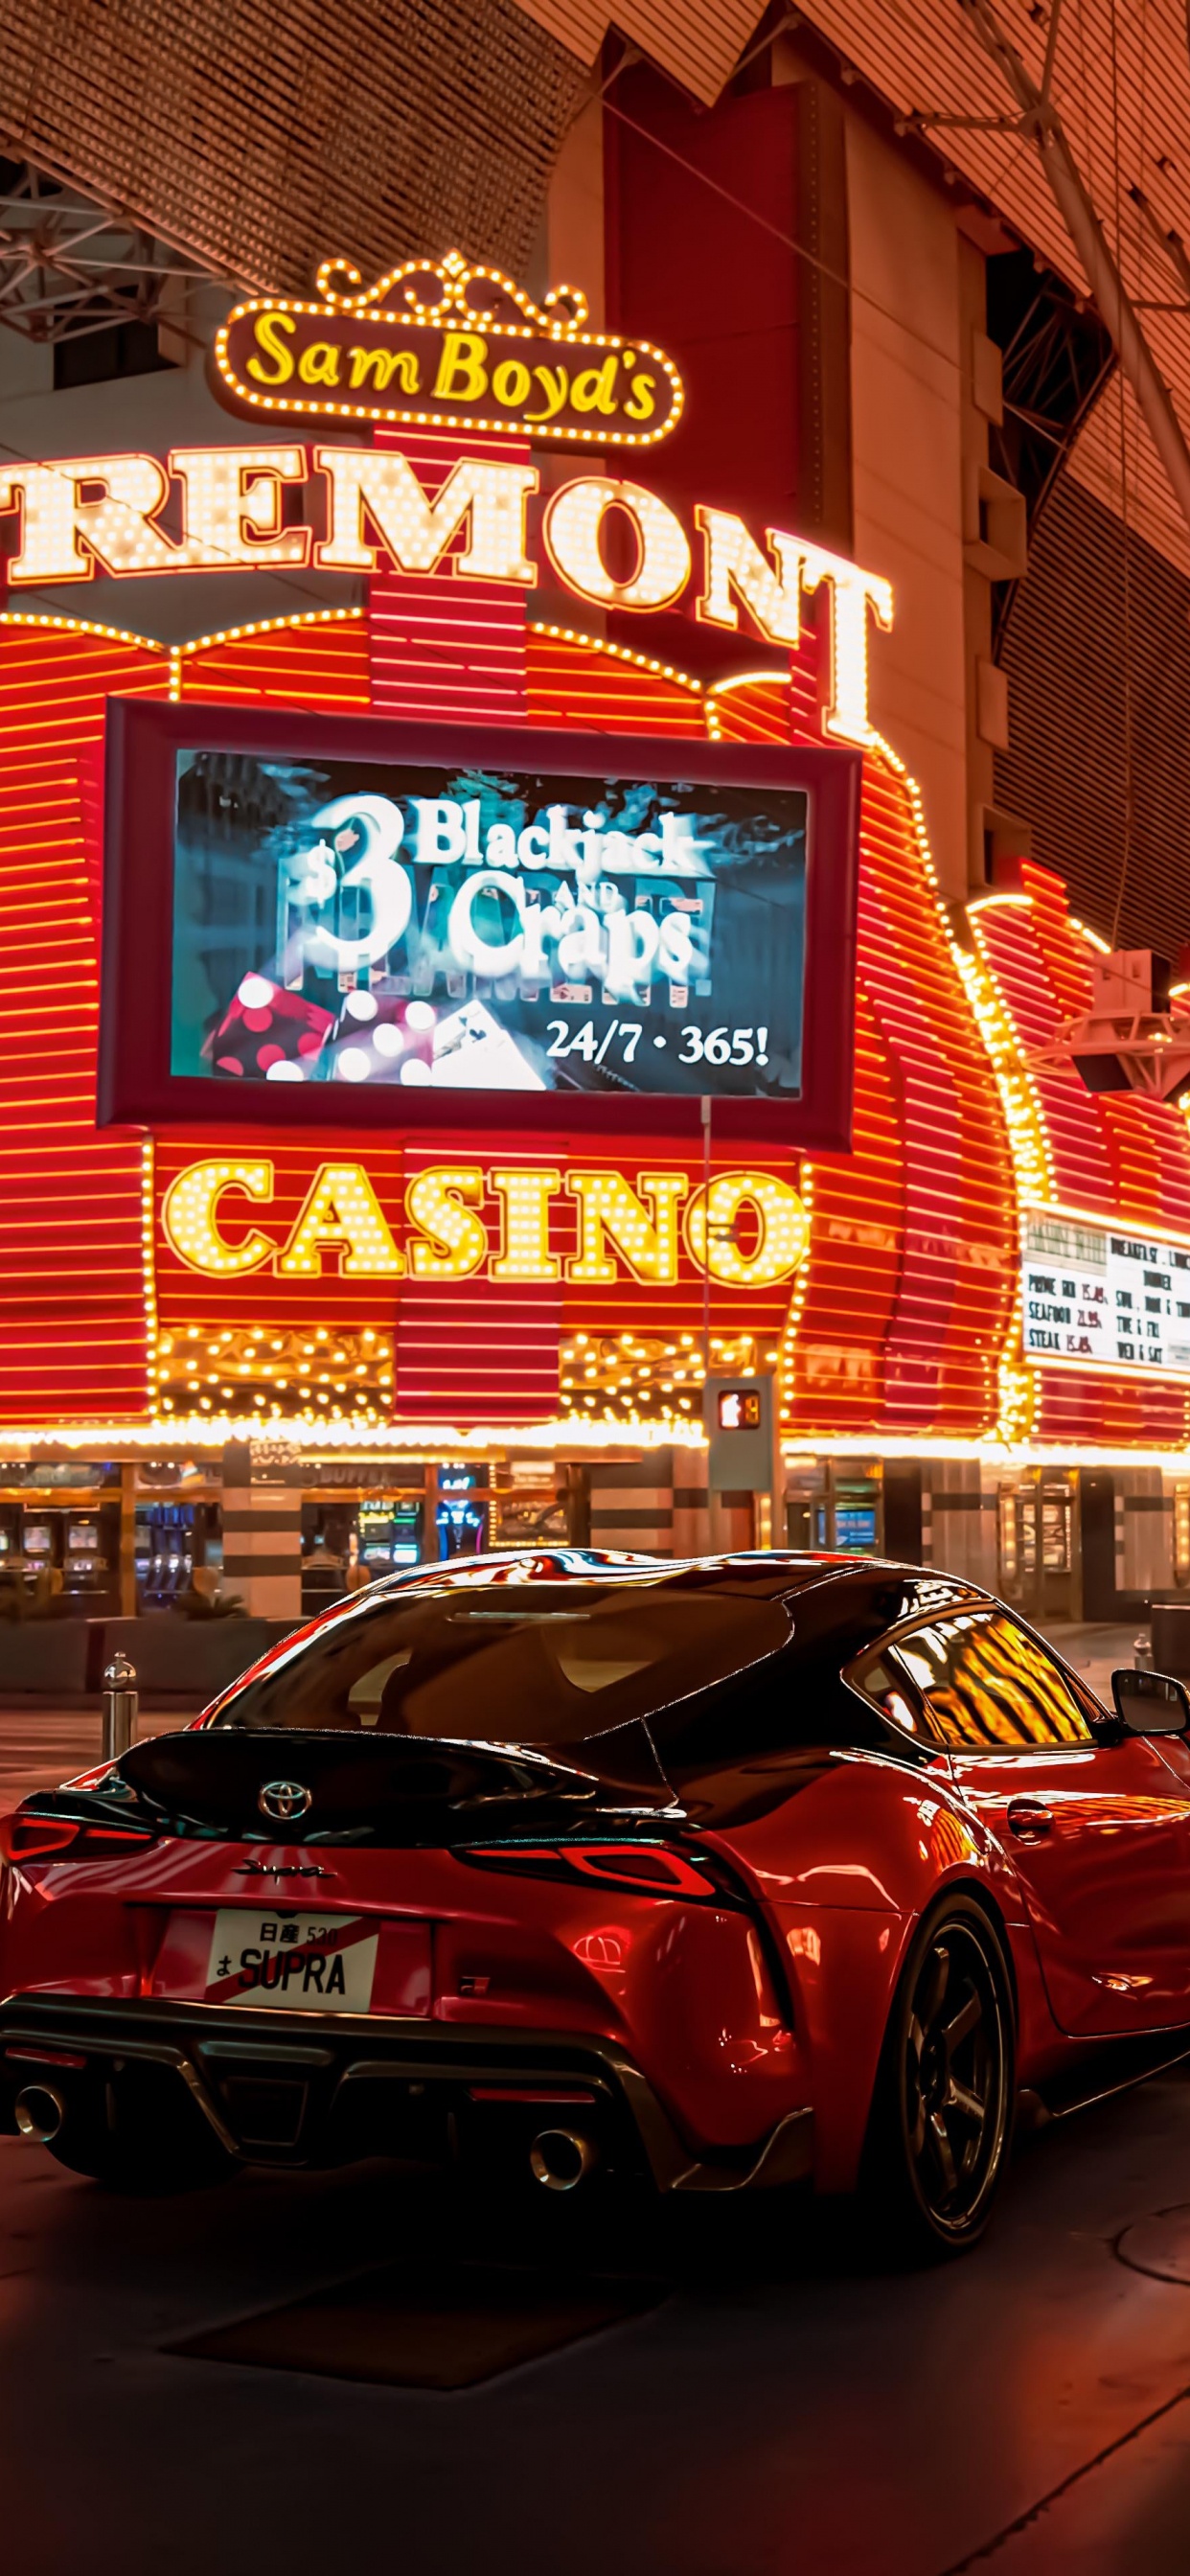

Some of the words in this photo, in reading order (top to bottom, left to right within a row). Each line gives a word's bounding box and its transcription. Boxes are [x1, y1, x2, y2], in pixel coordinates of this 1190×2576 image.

[246, 311, 420, 394] Sam
[431, 331, 657, 422] Boyd's
[410, 798, 701, 883] Blackjack
[305, 794, 413, 974] $3
[553, 879, 621, 911] AND
[448, 870, 695, 1004] Craps
[546, 1020, 643, 1064] 24/7
[678, 1025, 769, 1066] 365!
[161, 1158, 811, 1290] CASINO
[231, 1858, 338, 1886] Supra
[260, 1922, 300, 1944] 日産
[238, 1948, 346, 1995] SUPRA
